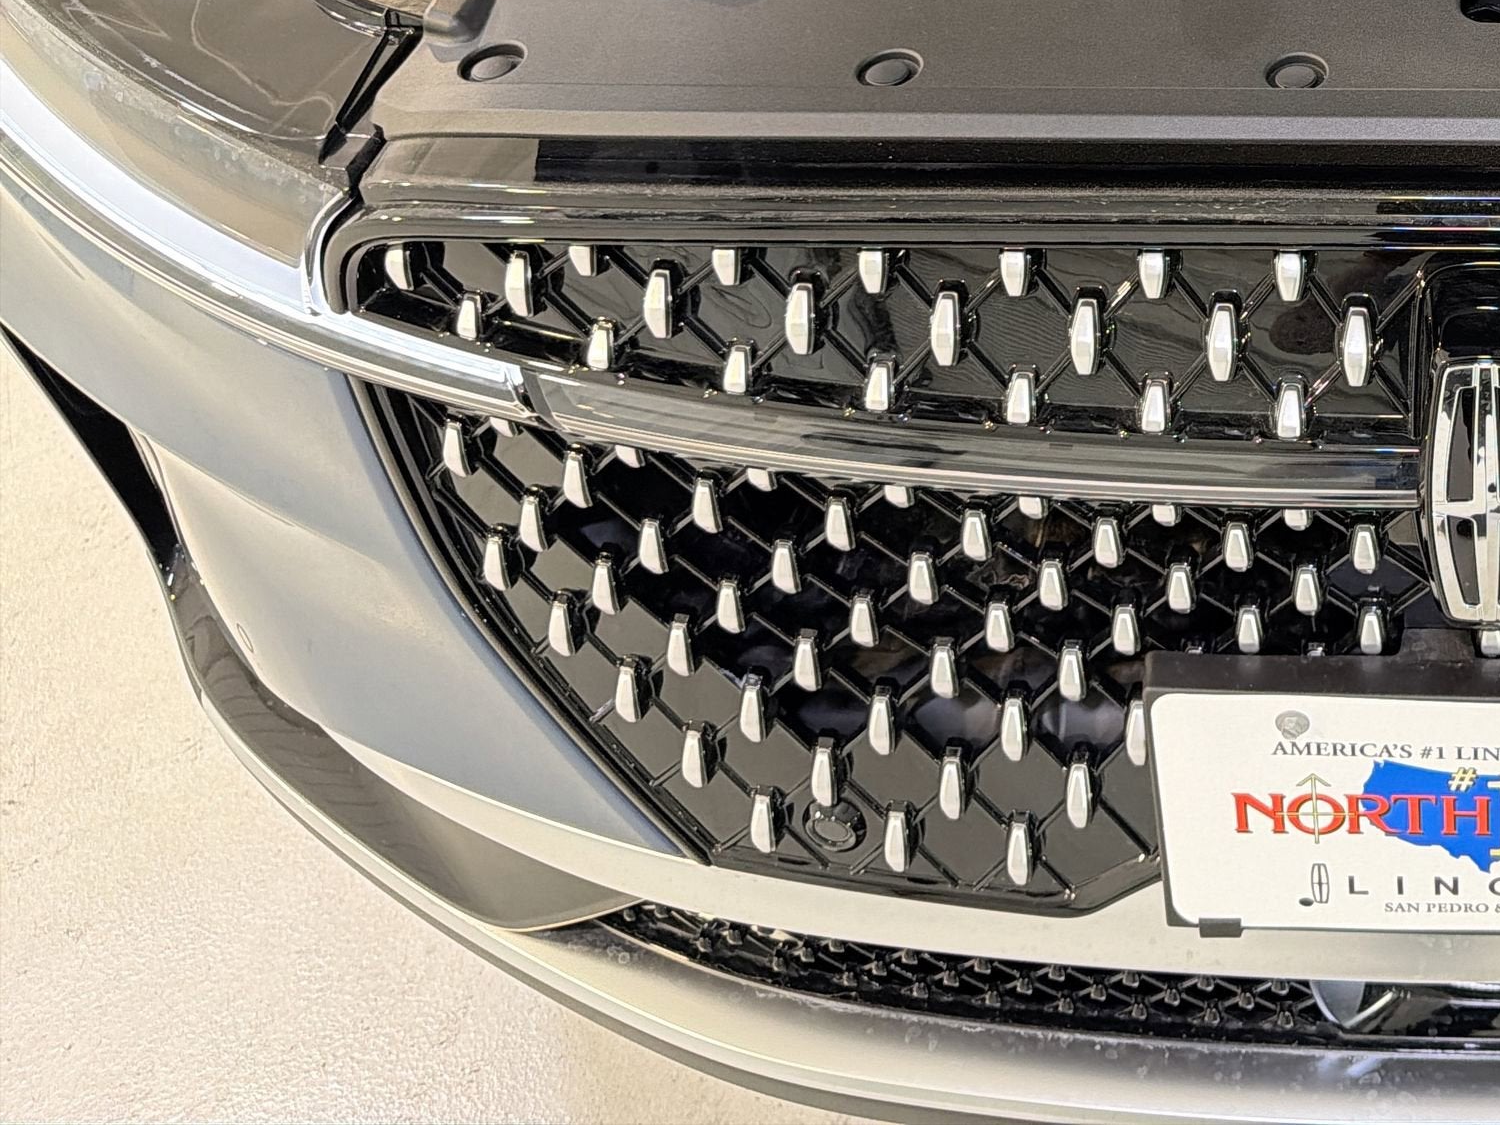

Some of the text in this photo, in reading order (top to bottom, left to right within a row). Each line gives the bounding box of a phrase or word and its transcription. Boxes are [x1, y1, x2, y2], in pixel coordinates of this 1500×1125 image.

[1271, 740, 1413, 760] AMERICA'S
[1420, 745, 1447, 761] #1
[1230, 791, 1494, 837] NORTH
[1384, 901, 1421, 914] SAN
[1426, 902, 1490, 915] PEDRO
